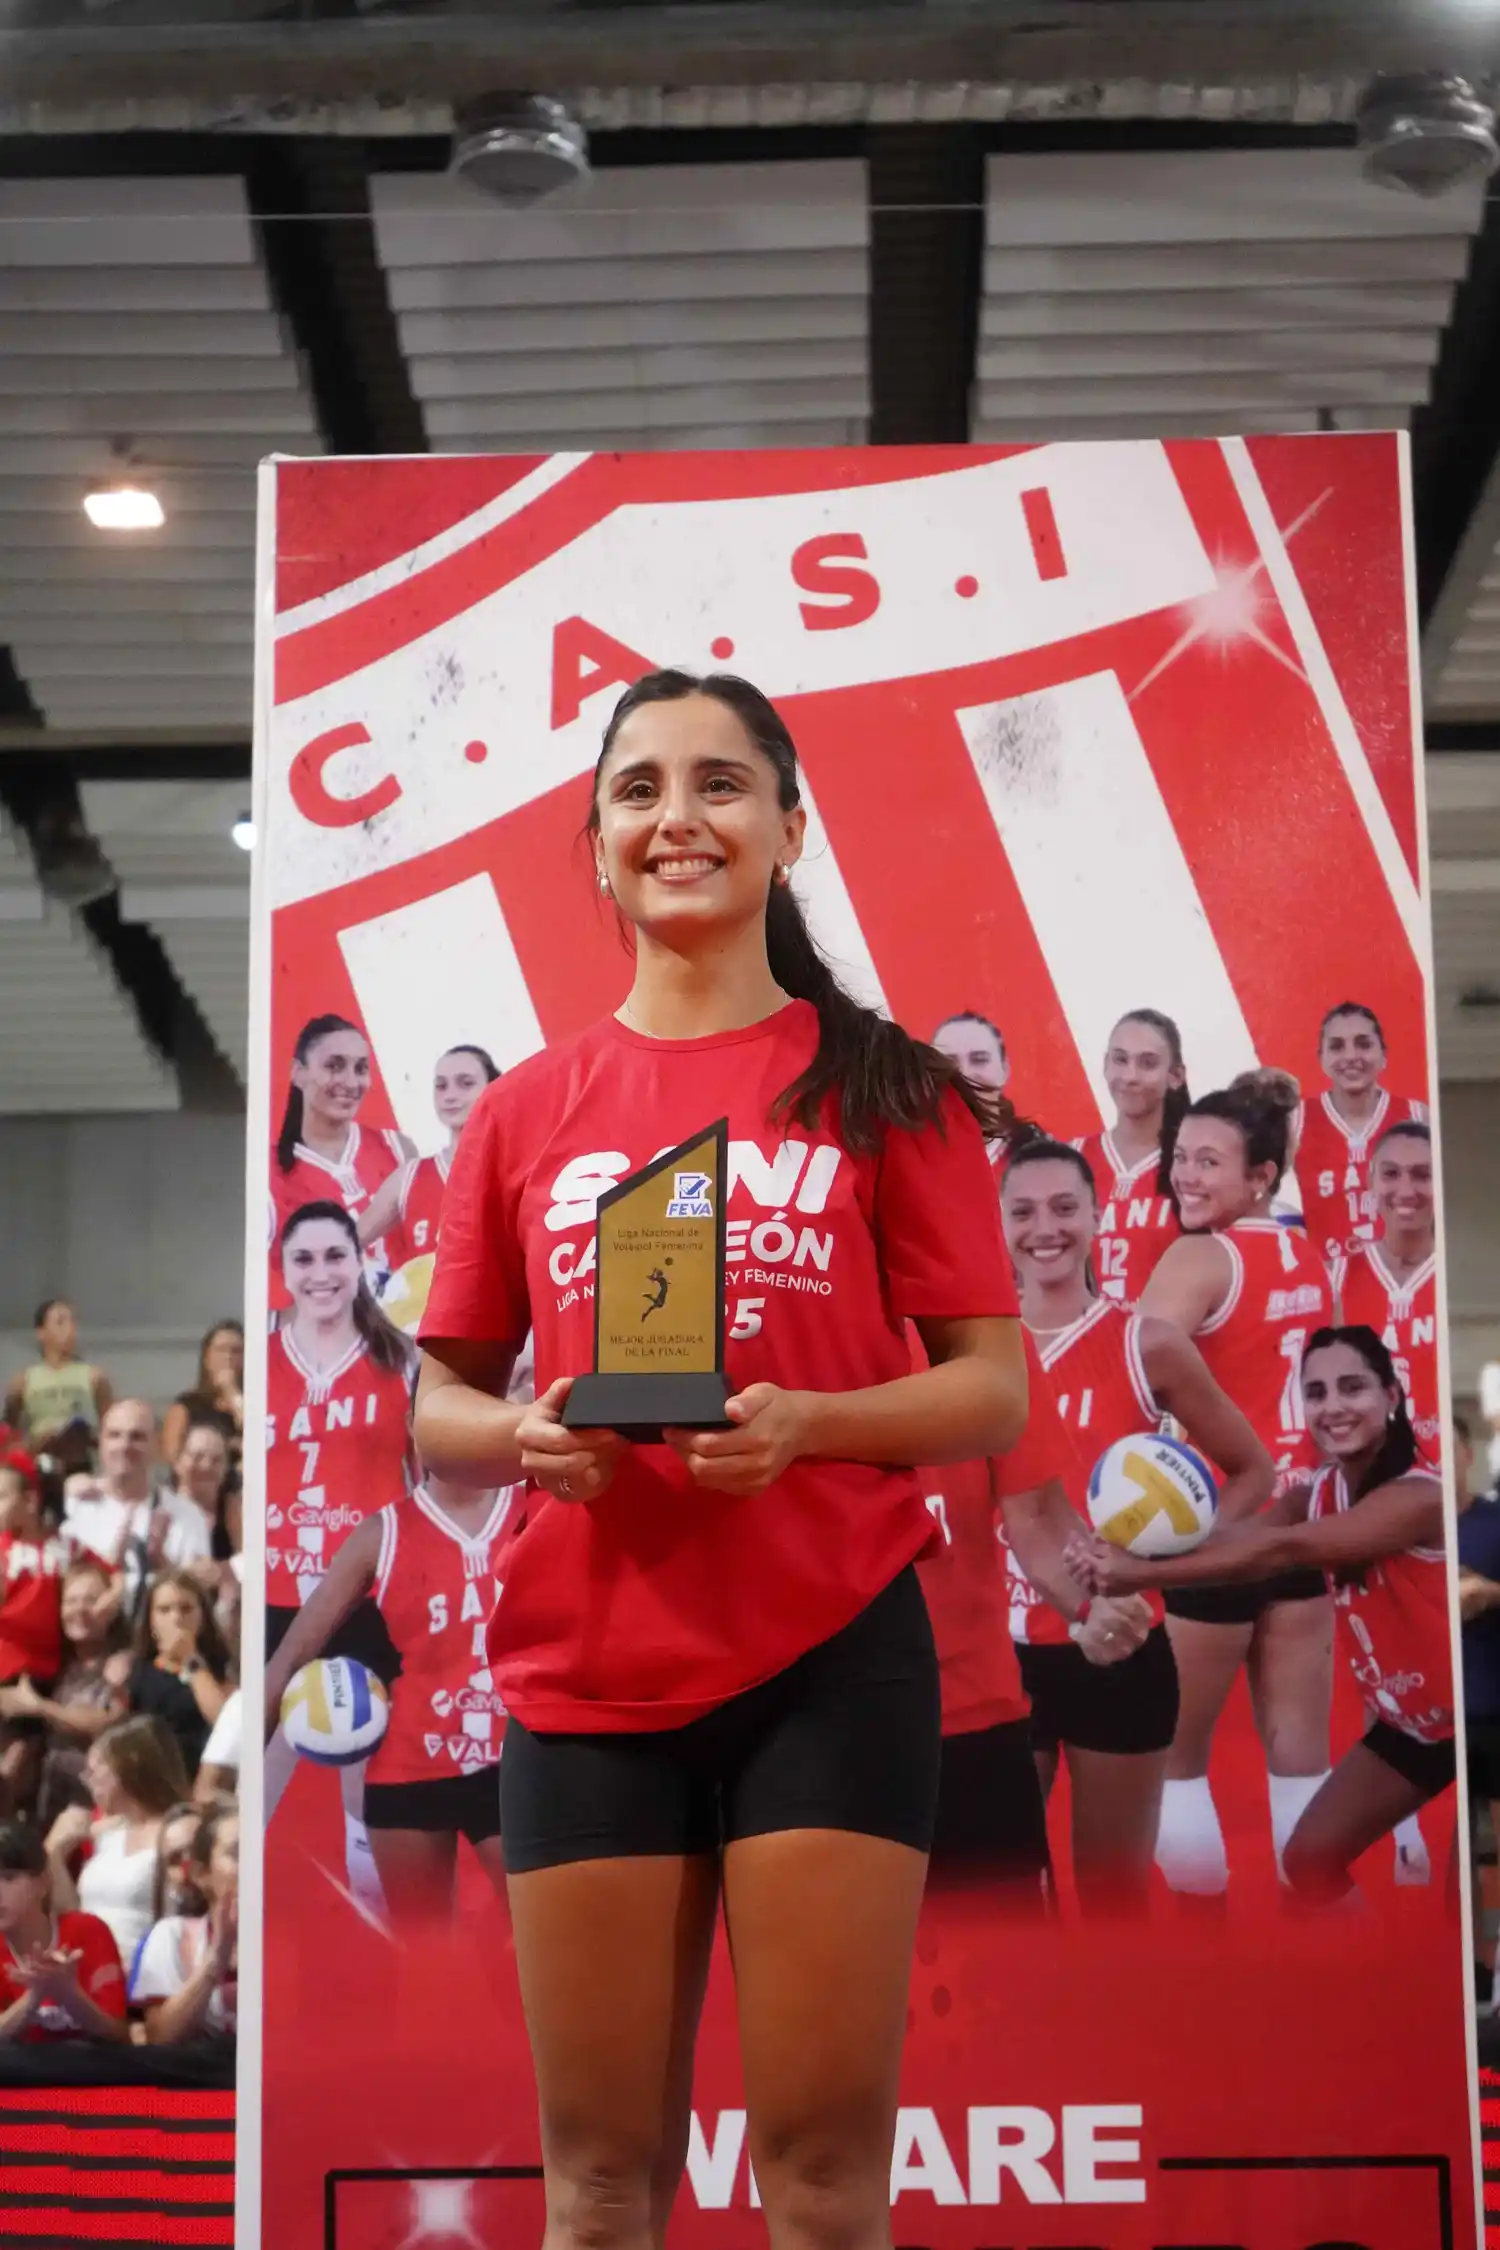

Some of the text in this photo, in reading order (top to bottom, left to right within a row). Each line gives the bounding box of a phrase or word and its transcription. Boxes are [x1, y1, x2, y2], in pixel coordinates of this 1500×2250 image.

[544, 1139, 842, 1232] SNI
[668, 1203, 711, 1216] FEVA
[1098, 1197, 1172, 1235] ANI
[549, 1211, 834, 1286] CAEÓN
[617, 1228, 699, 1239] Liga Nacional de
[1099, 1236, 1129, 1277] 12
[744, 1268, 832, 1296] FEMENINO
[556, 1288, 580, 1313] LIGA
[610, 1334, 644, 1345] MEJOR
[625, 1347, 690, 1357] DE LA FINAL
[299, 1442, 321, 1484] 7
[287, 1502, 364, 1532] Gaviglio
[890, 2104, 1147, 2206] ARE
